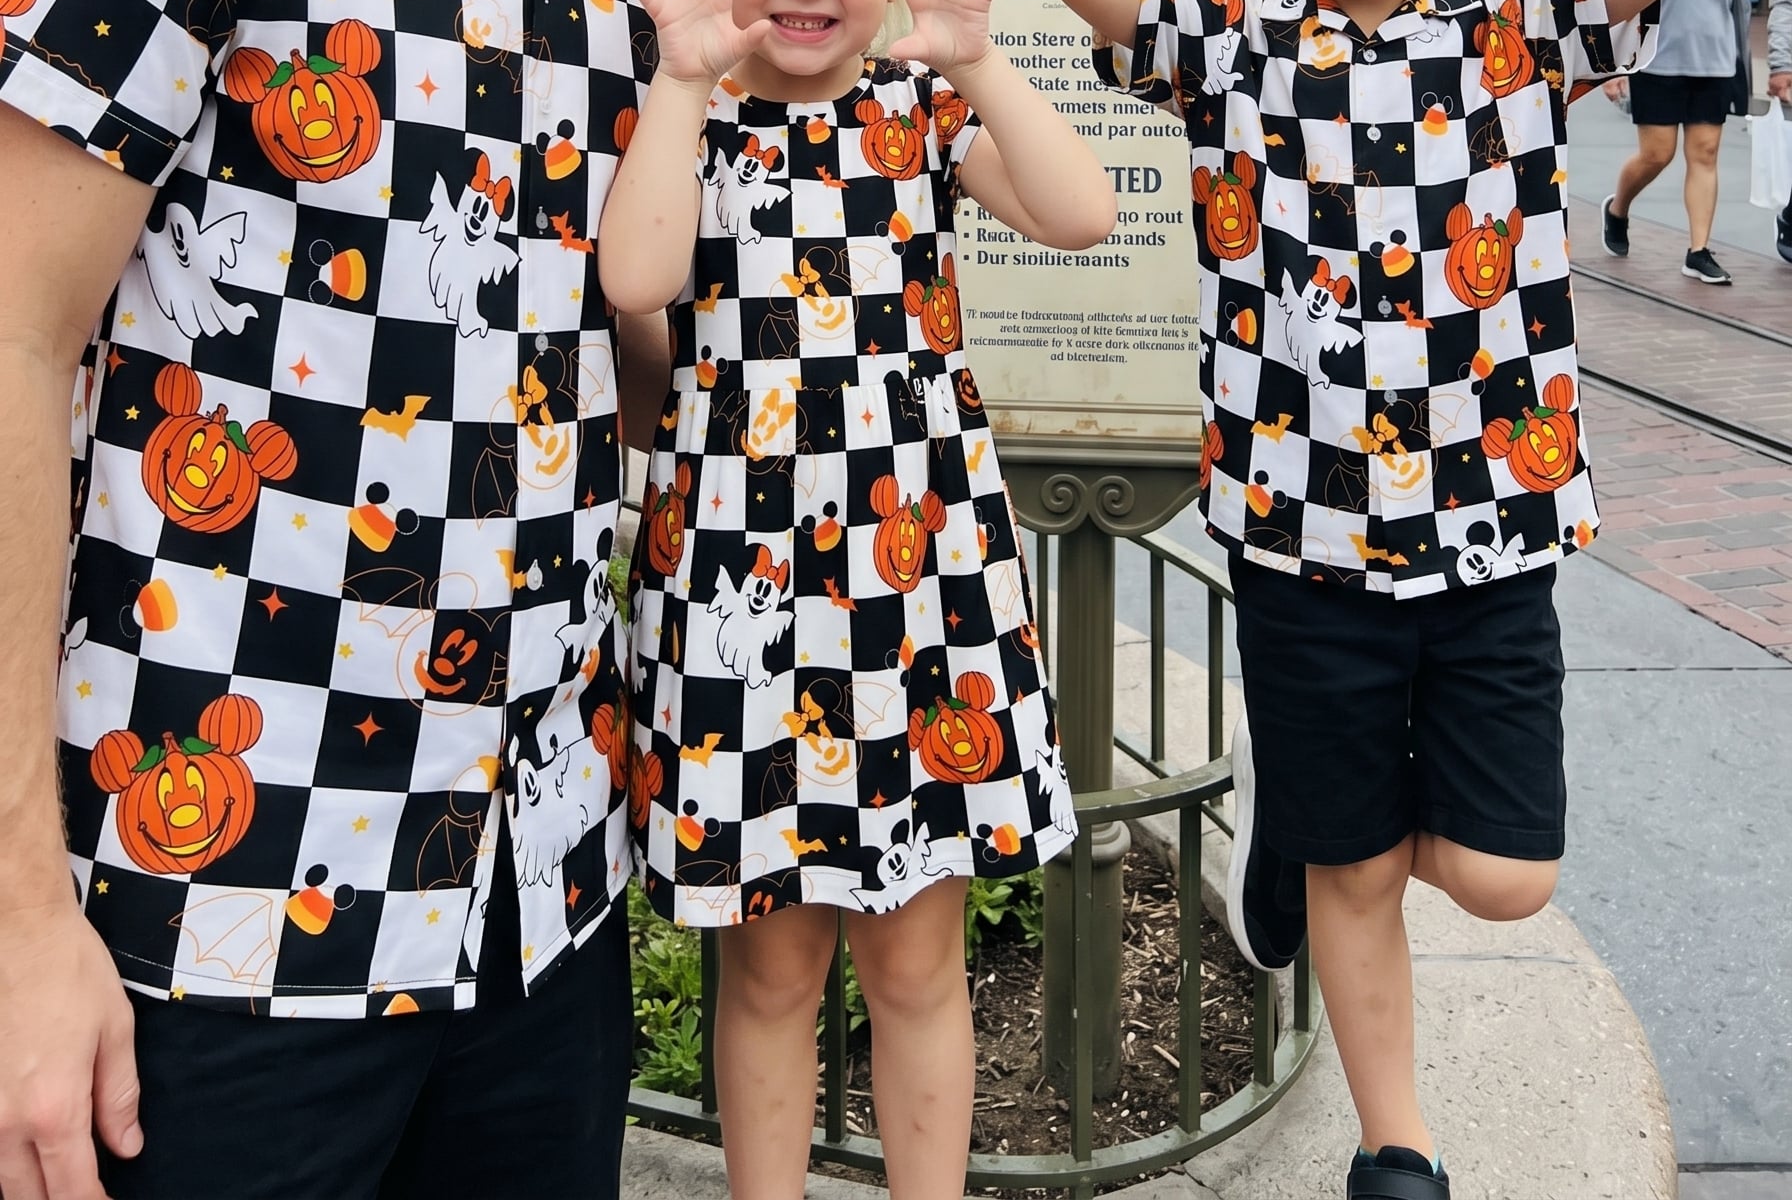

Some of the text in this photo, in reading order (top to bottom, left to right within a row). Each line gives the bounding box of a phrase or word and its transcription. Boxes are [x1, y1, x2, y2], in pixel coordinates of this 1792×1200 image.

[1028, 76, 1070, 91] State
[1108, 124, 1137, 140] par
[1104, 166, 1162, 194] TED
[1145, 210, 1184, 225] rout
[977, 250, 1009, 265] Dur
